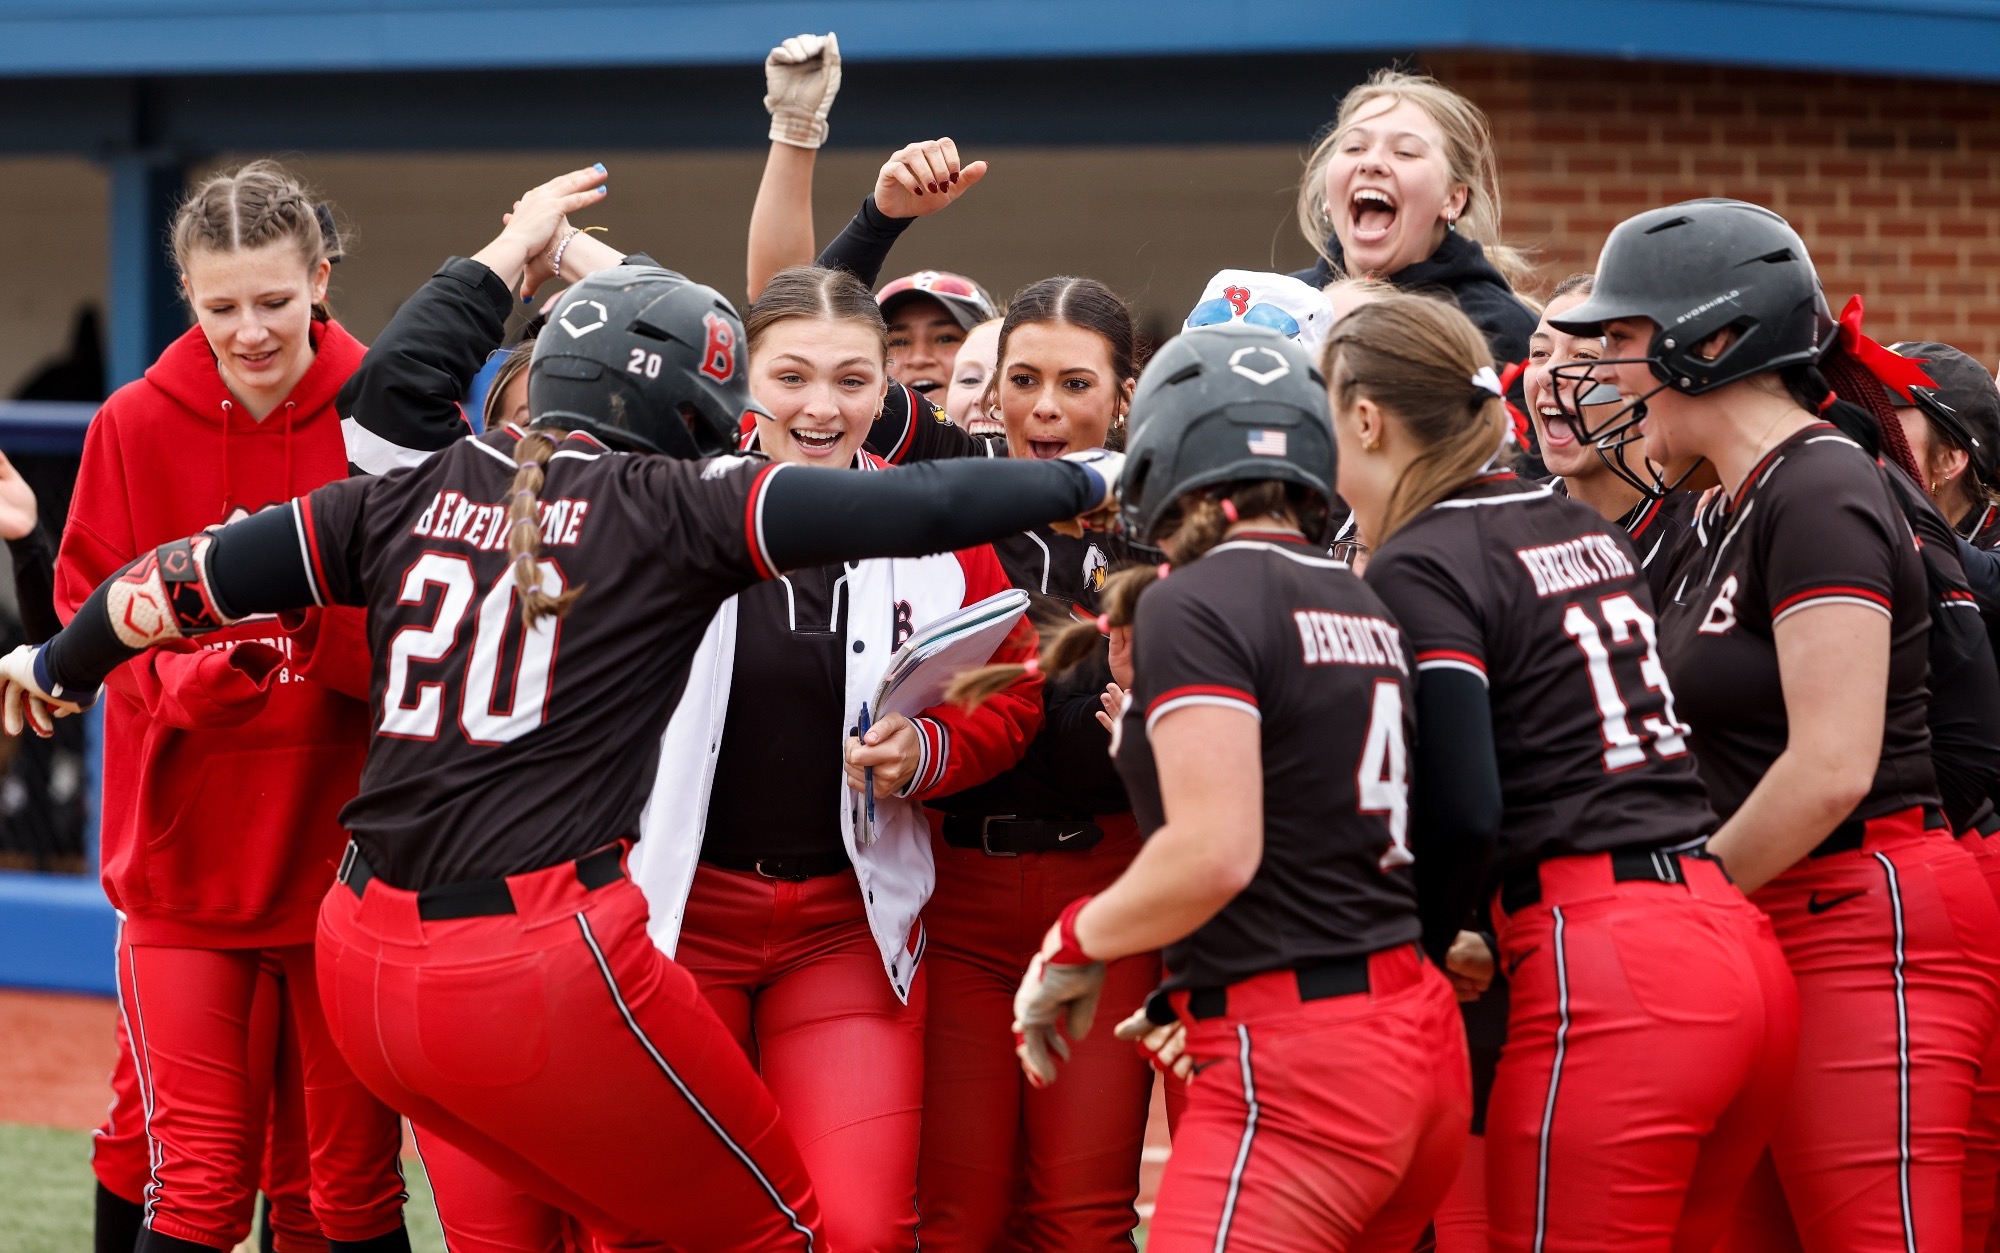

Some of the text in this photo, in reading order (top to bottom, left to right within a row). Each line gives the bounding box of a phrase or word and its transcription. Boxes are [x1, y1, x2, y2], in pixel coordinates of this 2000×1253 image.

[1223, 284, 1251, 317] B
[1676, 289, 1740, 324] EVOSHIELD
[627, 348, 662, 379] 20
[698, 310, 736, 385] B
[891, 599, 915, 655] B
[1696, 570, 1740, 636] B
[376, 550, 568, 747] 20
[1561, 591, 1692, 774] 13
[1355, 677, 1416, 874] 4
